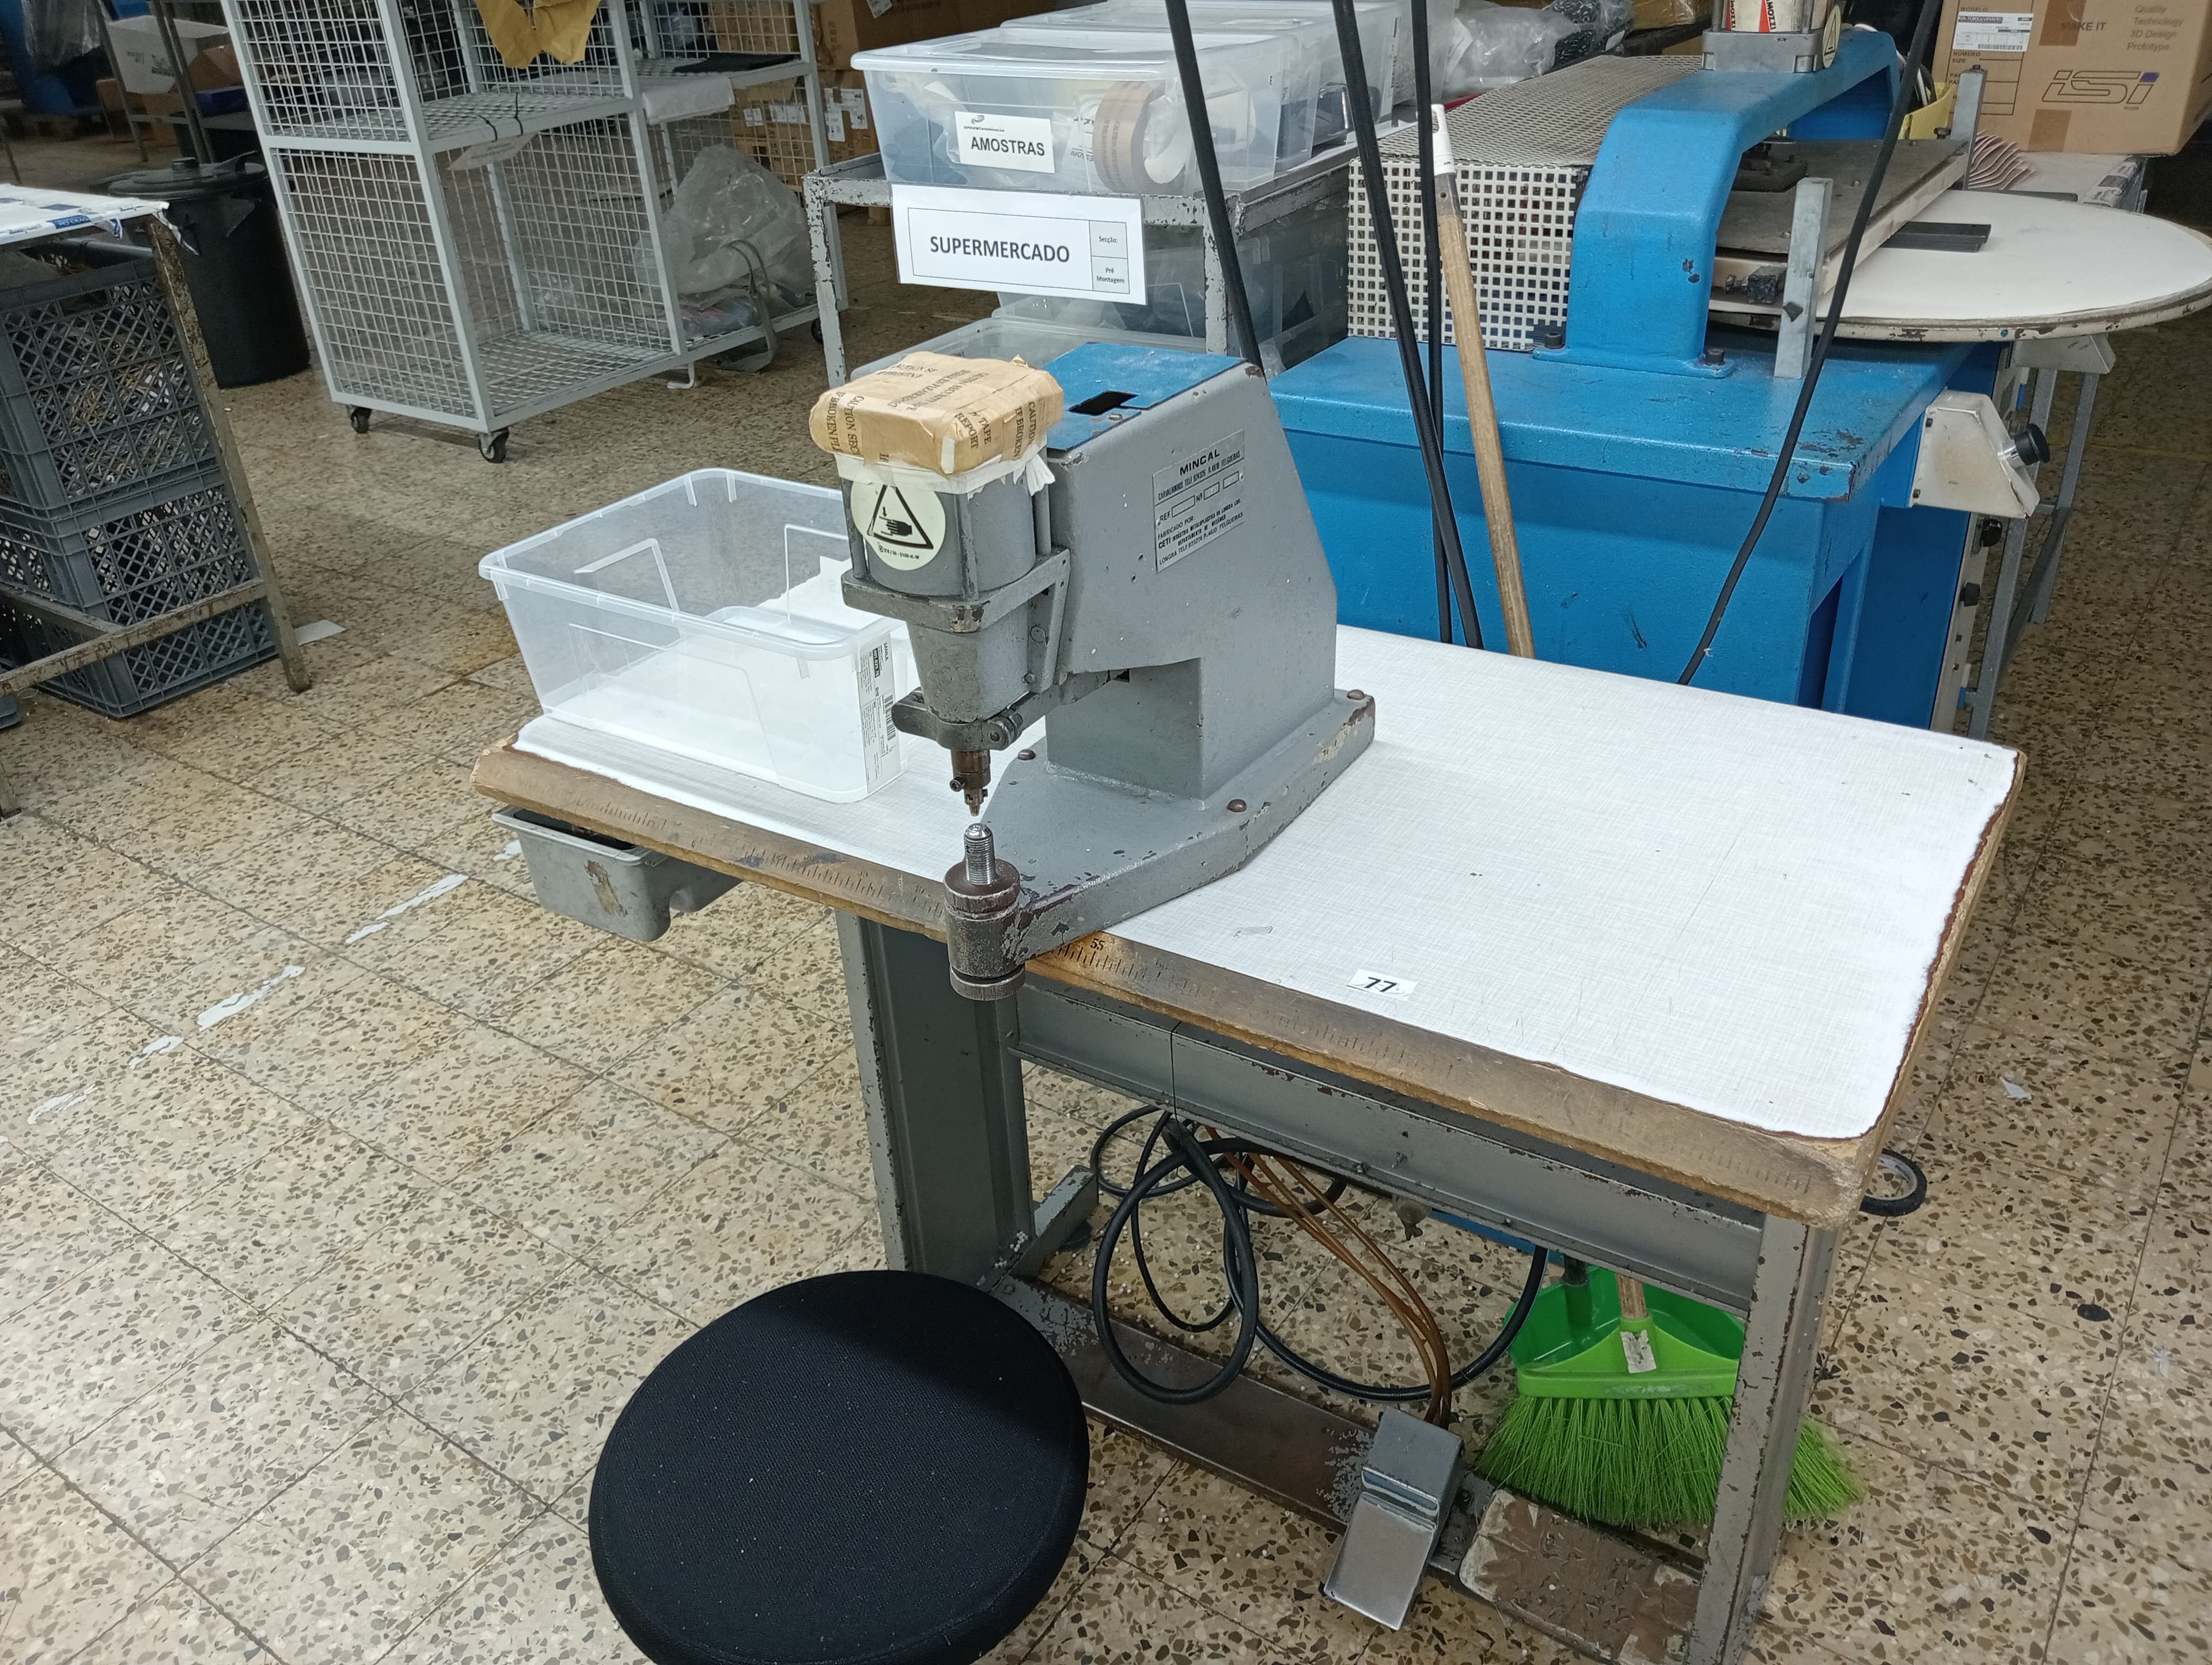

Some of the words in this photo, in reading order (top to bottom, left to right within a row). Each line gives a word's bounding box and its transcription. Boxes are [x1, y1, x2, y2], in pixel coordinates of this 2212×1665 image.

[2135, 5, 2167, 14] Quality
[2096, 22, 2106, 31] IT
[2134, 17, 2184, 26] Technology
[2130, 29, 2143, 38] 3D
[2145, 30, 2177, 40] Design
[2127, 42, 2170, 52] Prototype
[971, 136, 1045, 156] AMOSTRAS
[1099, 236, 1118, 244] Secção:
[930, 236, 1070, 263] SUPERMERCADO
[1096, 275, 1125, 285] Montagem
[827, 397, 840, 436] BROKEN
[844, 396, 865, 431] CAUTION
[1014, 407, 1023, 416] IF
[954, 412, 979, 449] REPORT
[978, 417, 991, 445] TAPE
[1158, 522, 1183, 540] FABRICADO
[1090, 938, 1105, 951] 55
[1363, 977, 1397, 992] 77
